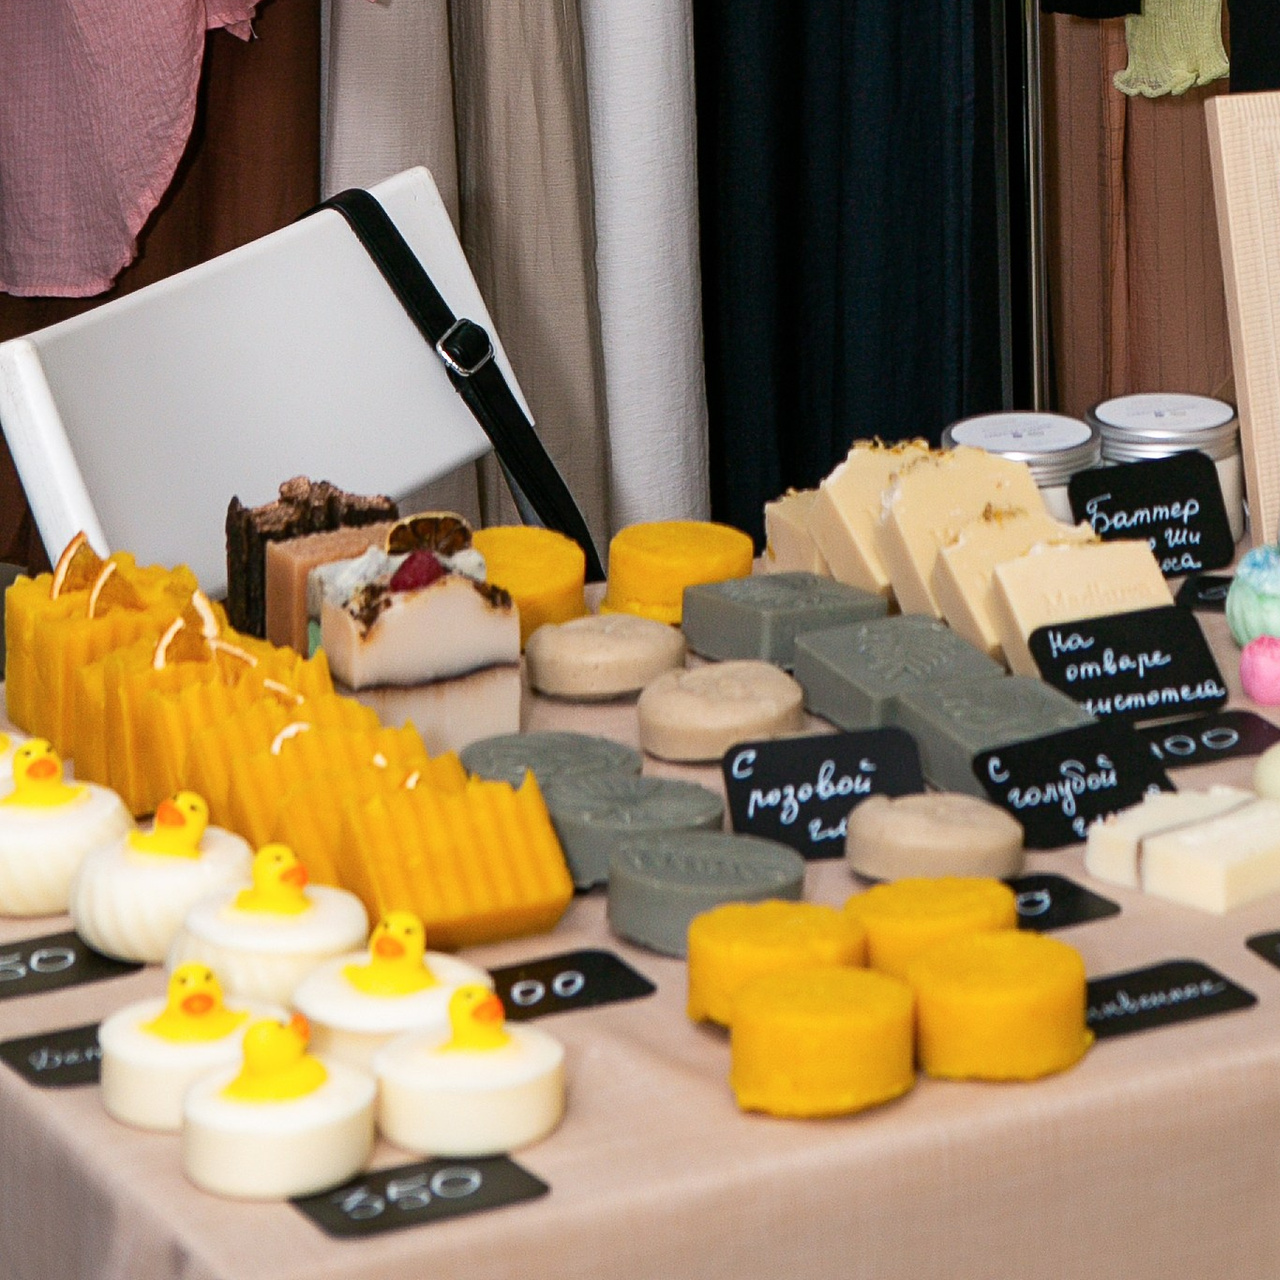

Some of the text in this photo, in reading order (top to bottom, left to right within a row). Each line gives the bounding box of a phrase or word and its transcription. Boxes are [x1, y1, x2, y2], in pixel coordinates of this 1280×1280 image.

[1085, 492, 1199, 533] Баттер
[1048, 630, 1095, 658] На
[1065, 647, 1172, 682] отваре
[732, 749, 757, 780] С
[987, 756, 1010, 783] С
[747, 757, 878, 825] розовой
[1007, 753, 1117, 817] голубой
